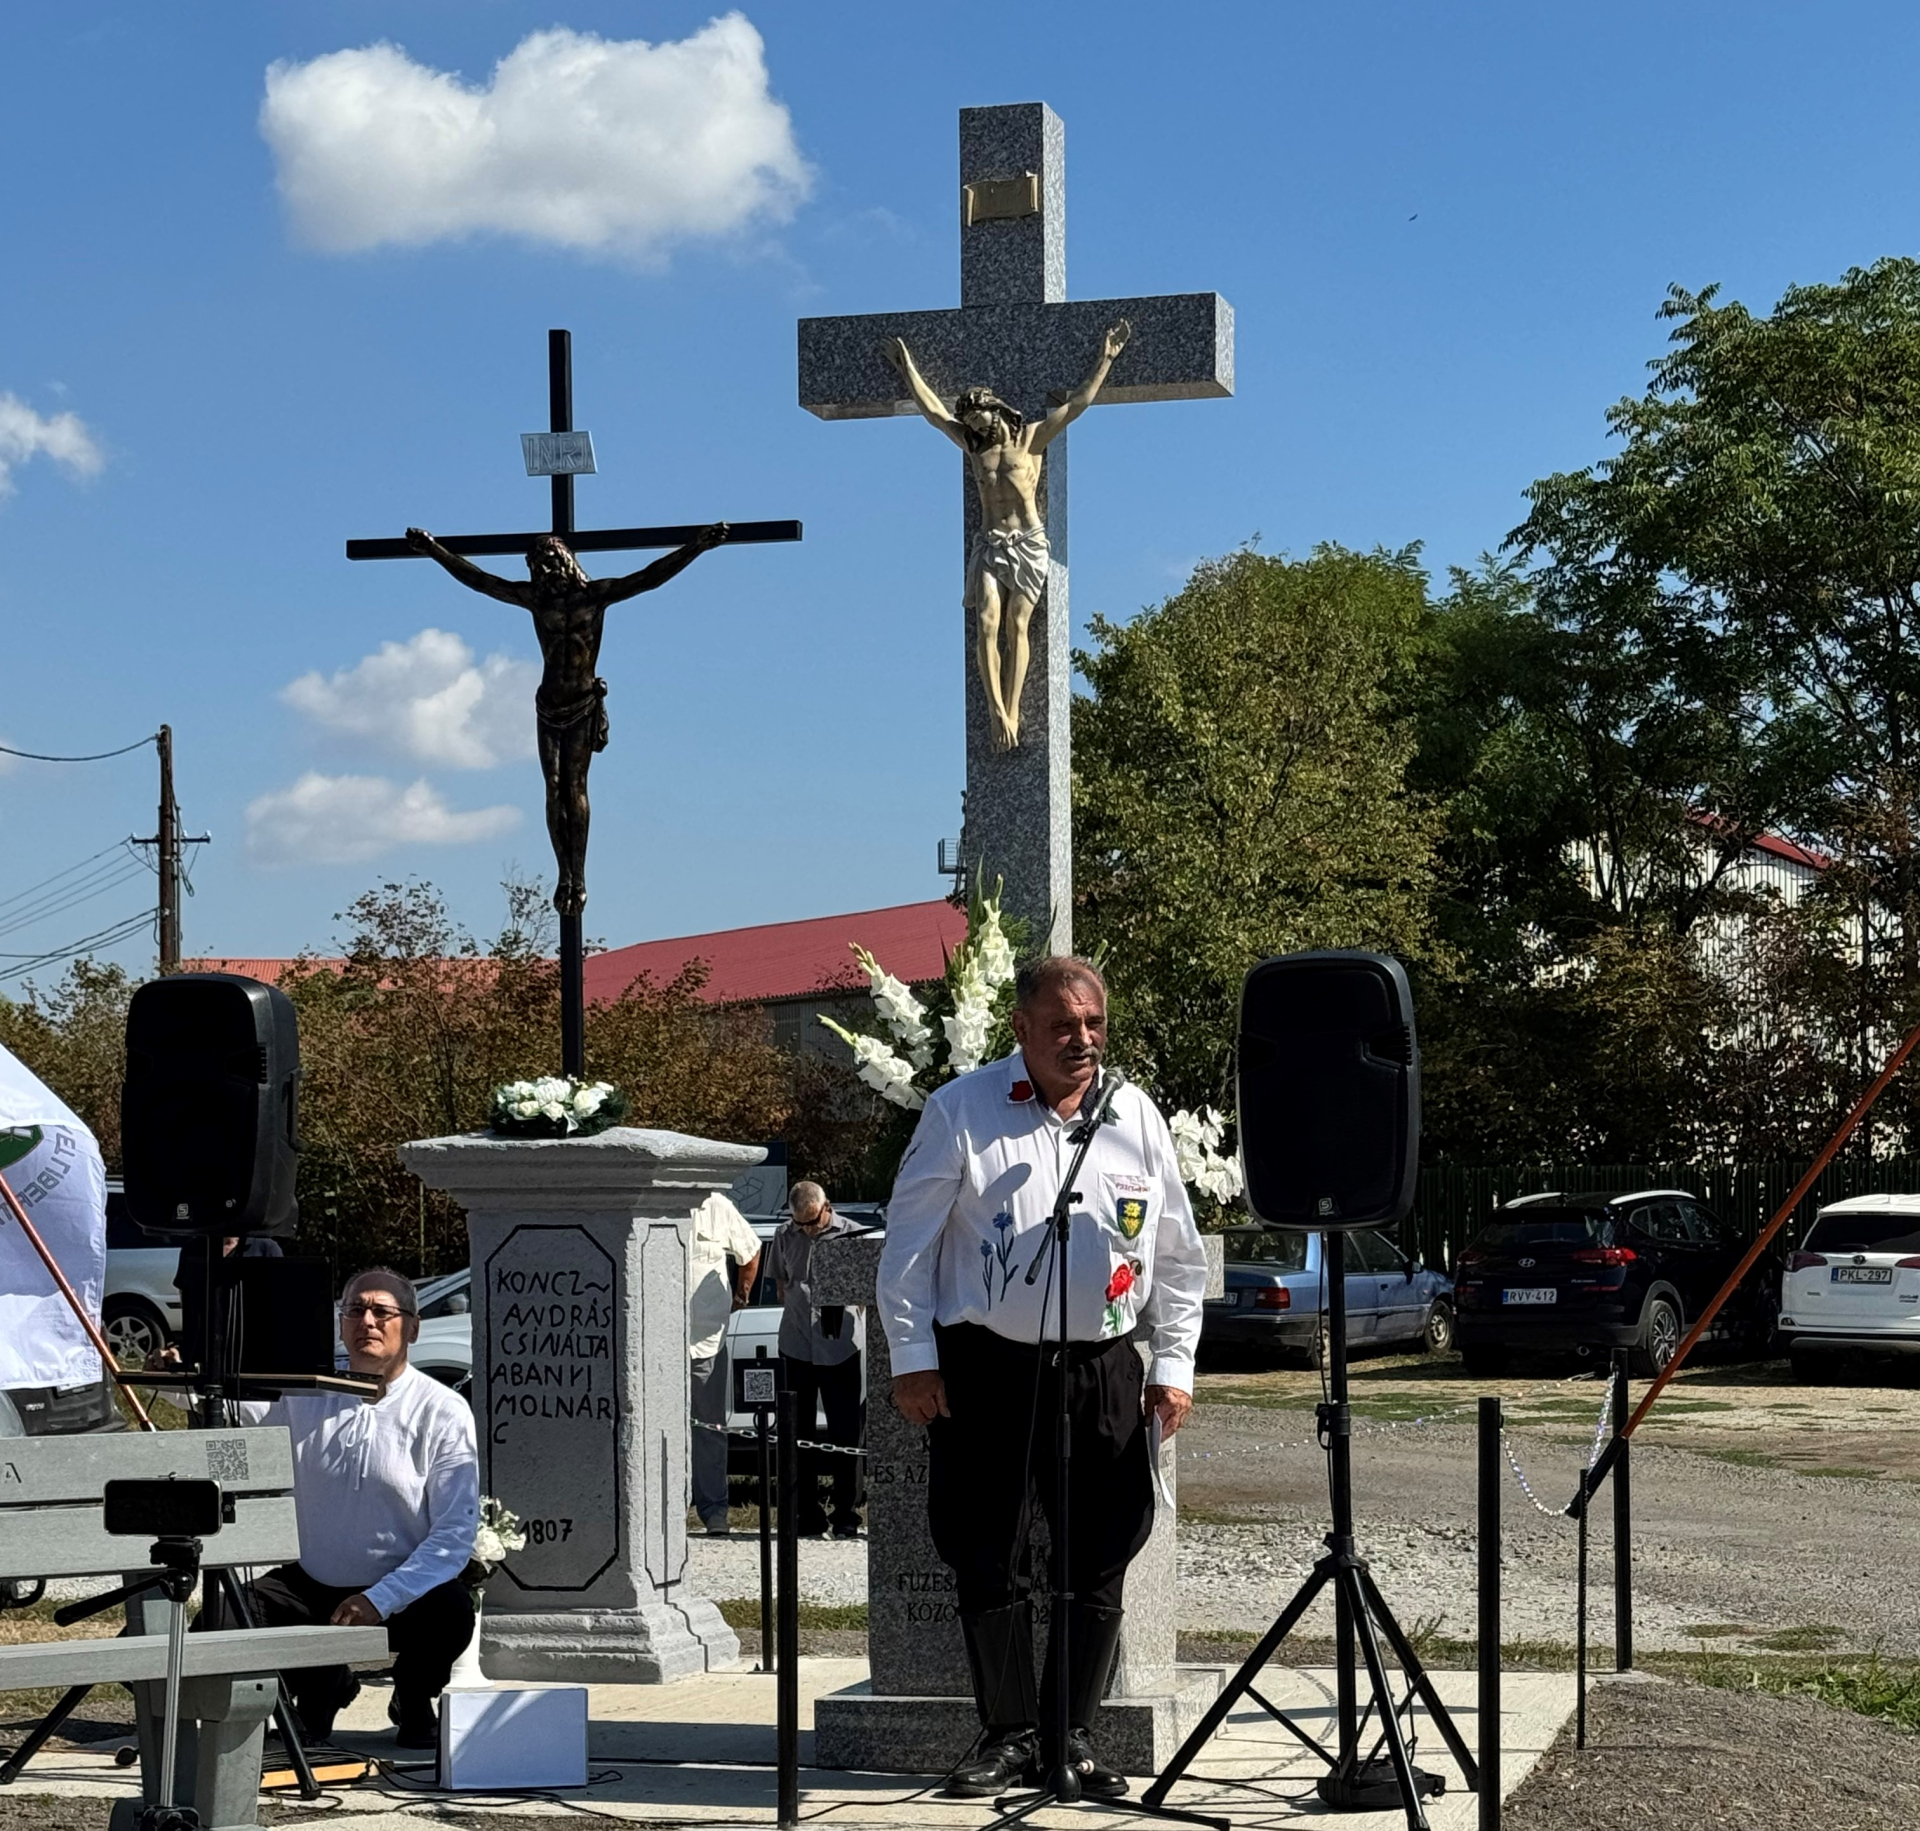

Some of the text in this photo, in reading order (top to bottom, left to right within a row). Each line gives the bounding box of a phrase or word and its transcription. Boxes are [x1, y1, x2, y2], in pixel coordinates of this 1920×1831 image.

[503, 1297, 611, 1328] ANDRÁS
[495, 1388, 612, 1419] MOLNÁR
[493, 1421, 509, 1444] C
[519, 1518, 573, 1544] 1807
